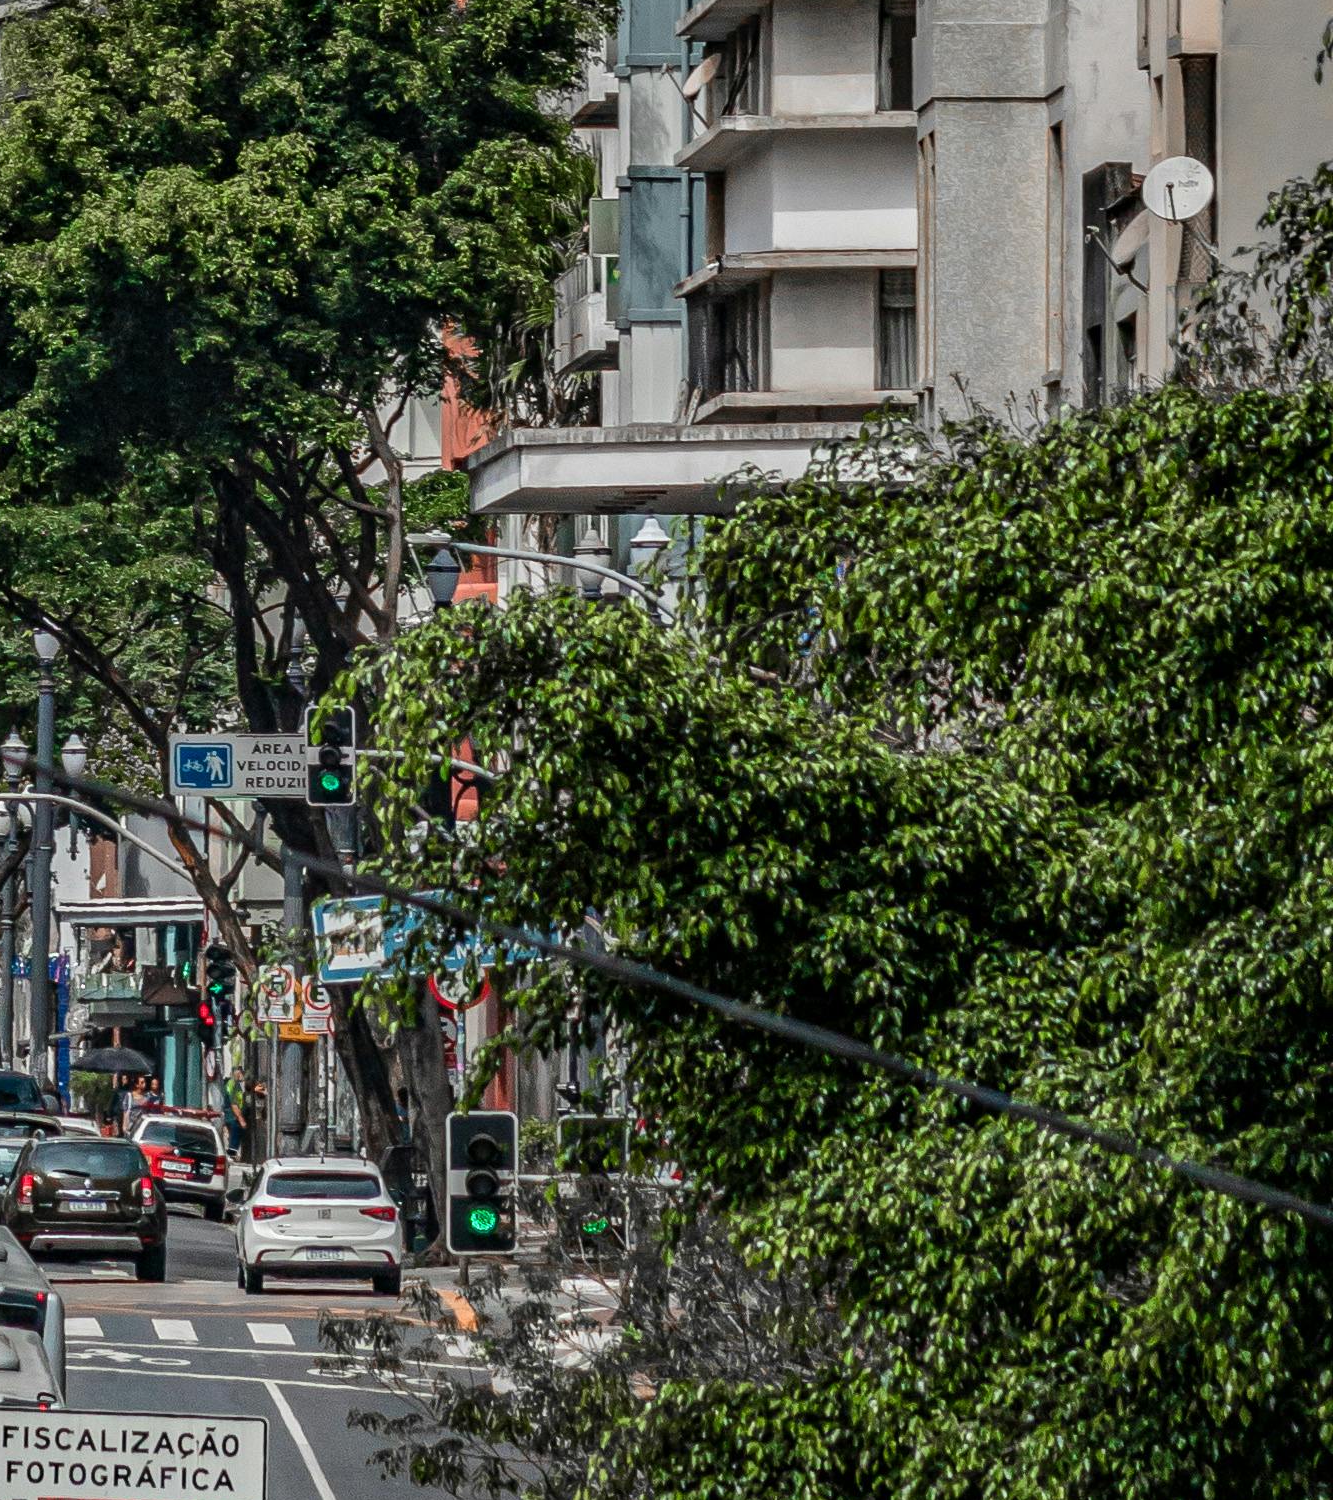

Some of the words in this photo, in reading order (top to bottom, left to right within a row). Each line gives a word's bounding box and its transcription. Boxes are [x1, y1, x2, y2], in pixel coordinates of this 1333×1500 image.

[251, 741, 293, 755] ÁREA
[1, 1425, 240, 1459] FISCALIZAÇÃO
[6, 1460, 235, 1491] FOTOGRÁFICA
